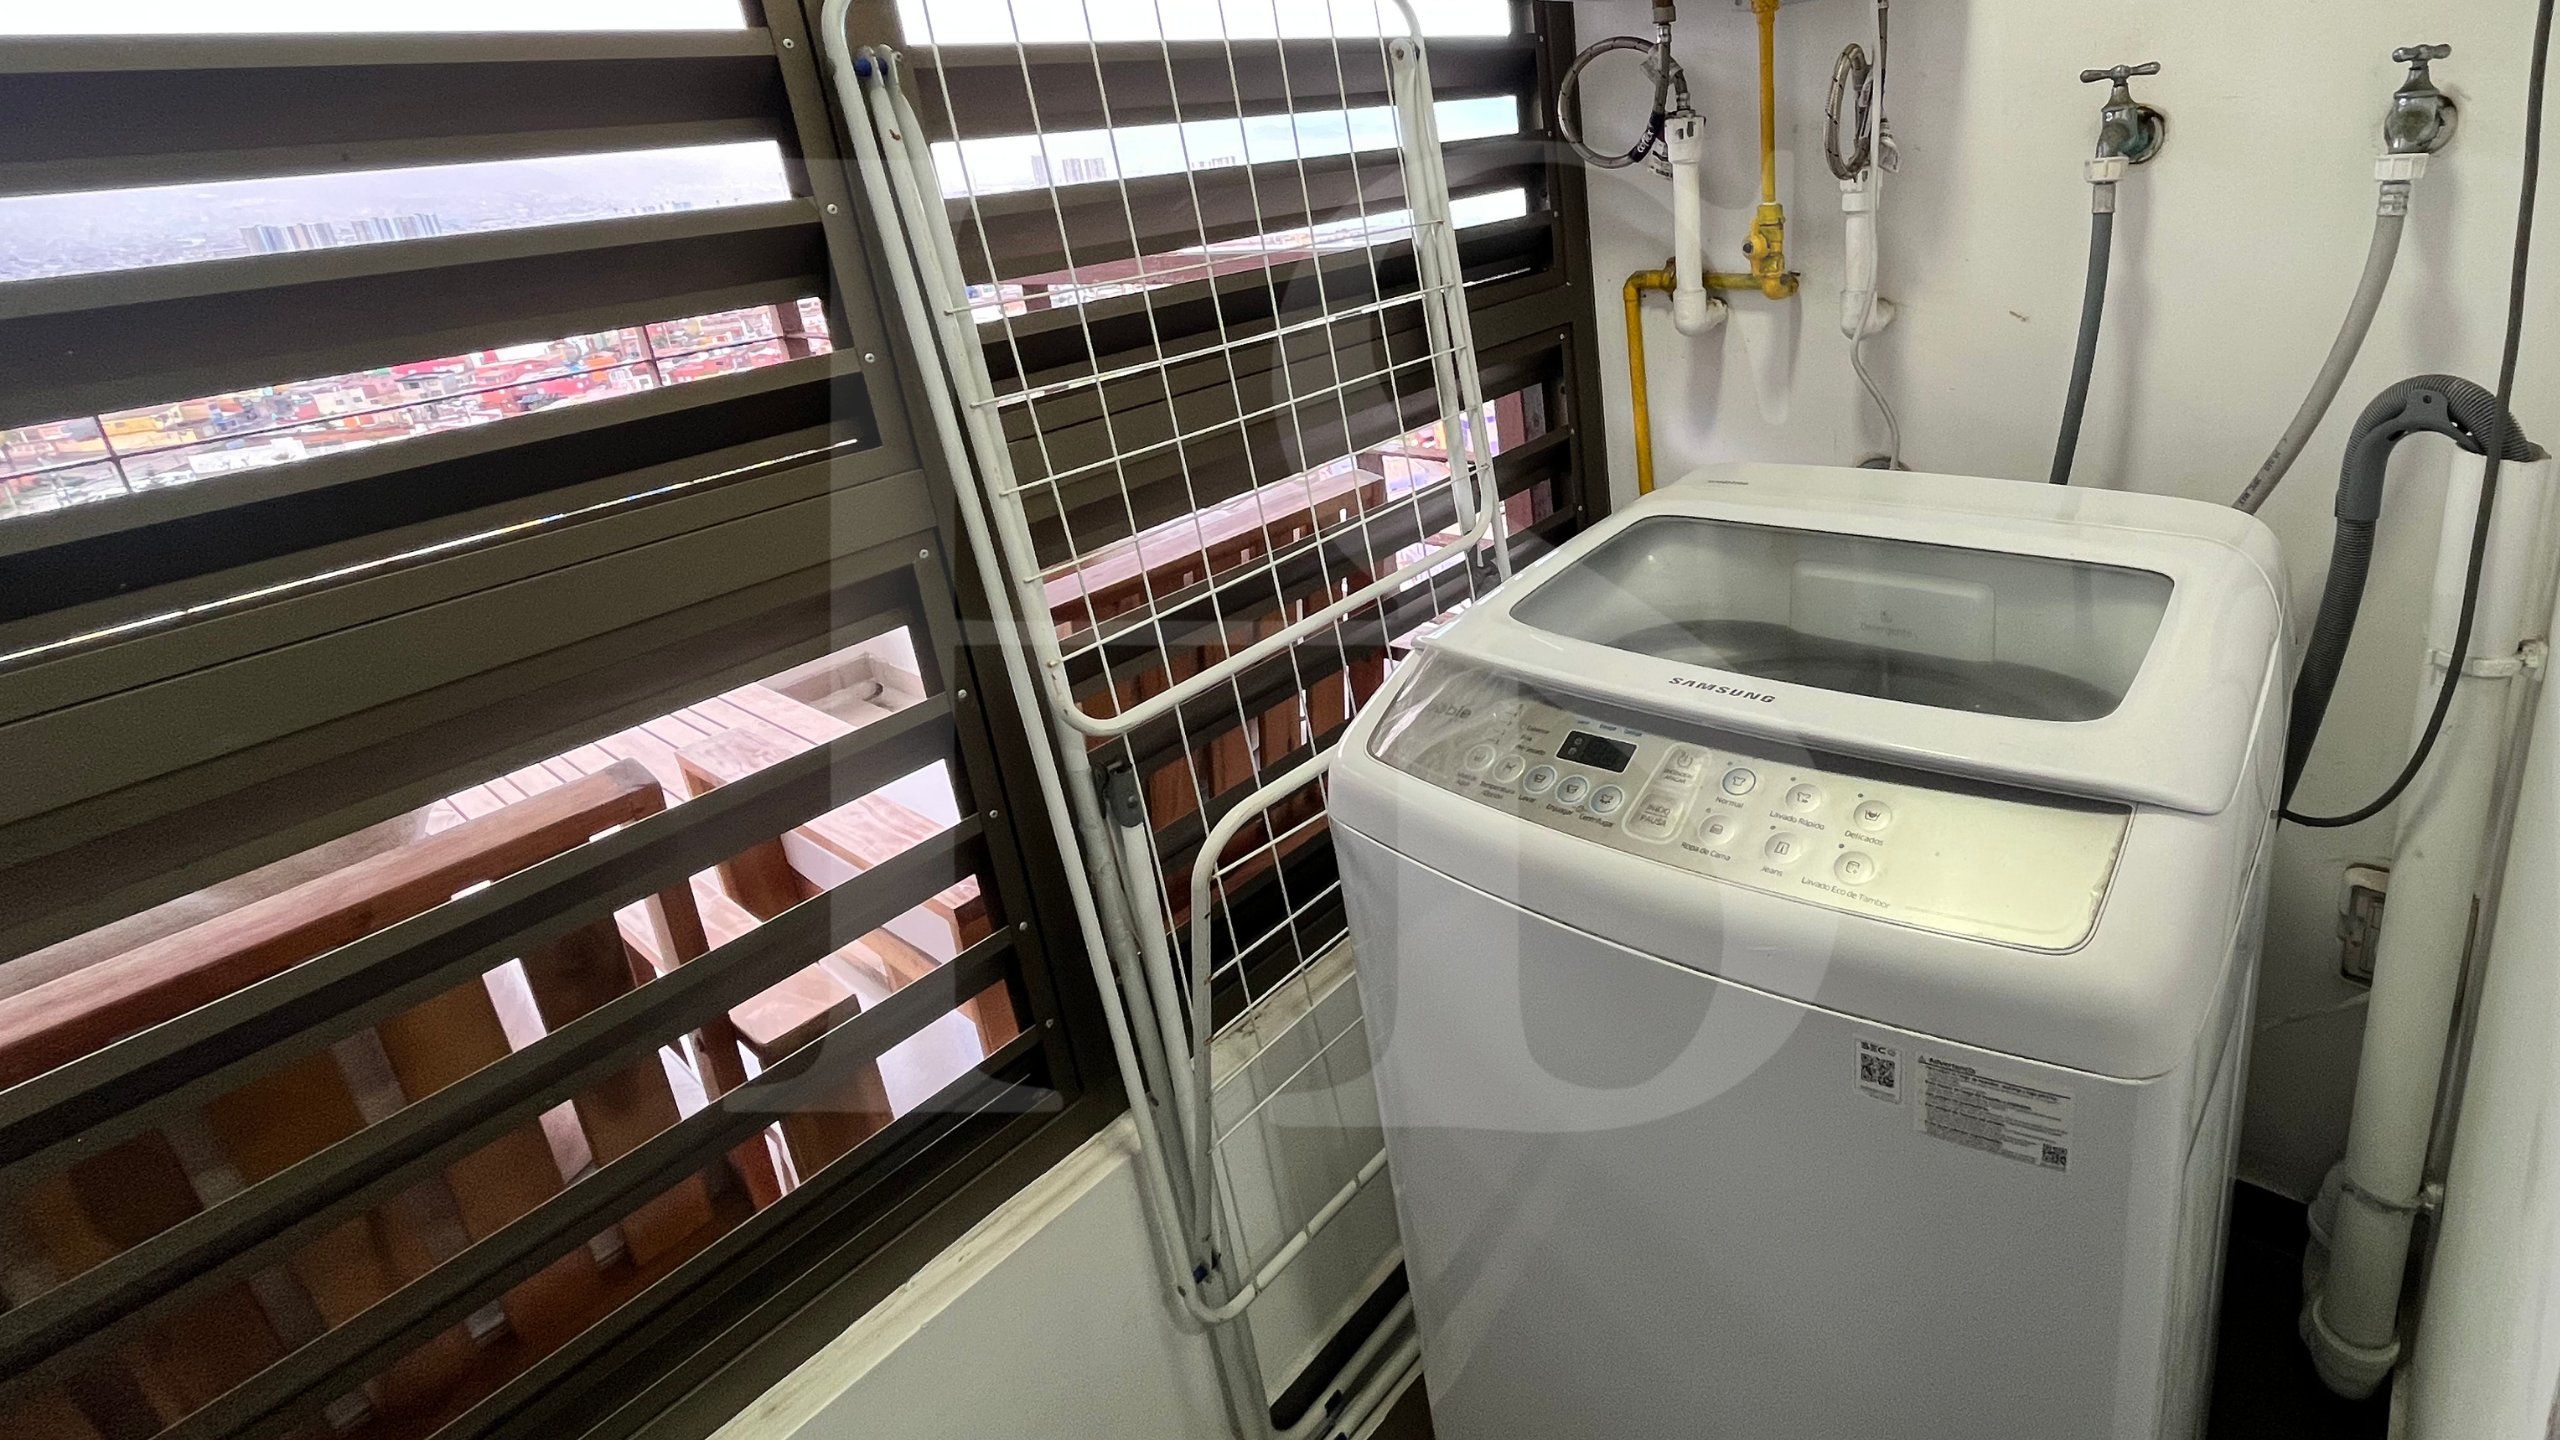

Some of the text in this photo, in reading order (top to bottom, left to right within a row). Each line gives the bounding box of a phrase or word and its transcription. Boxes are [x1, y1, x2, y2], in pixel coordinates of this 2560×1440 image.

[1668, 677, 1776, 703] SAMSUNG
[1715, 796, 1744, 809] Normal
[1769, 810, 1797, 825] Lavado
[1844, 830, 1884, 846] Delicados
[1760, 865, 1783, 877] Jeans
[1801, 876, 1890, 909] Lavado Eco de Tambor
